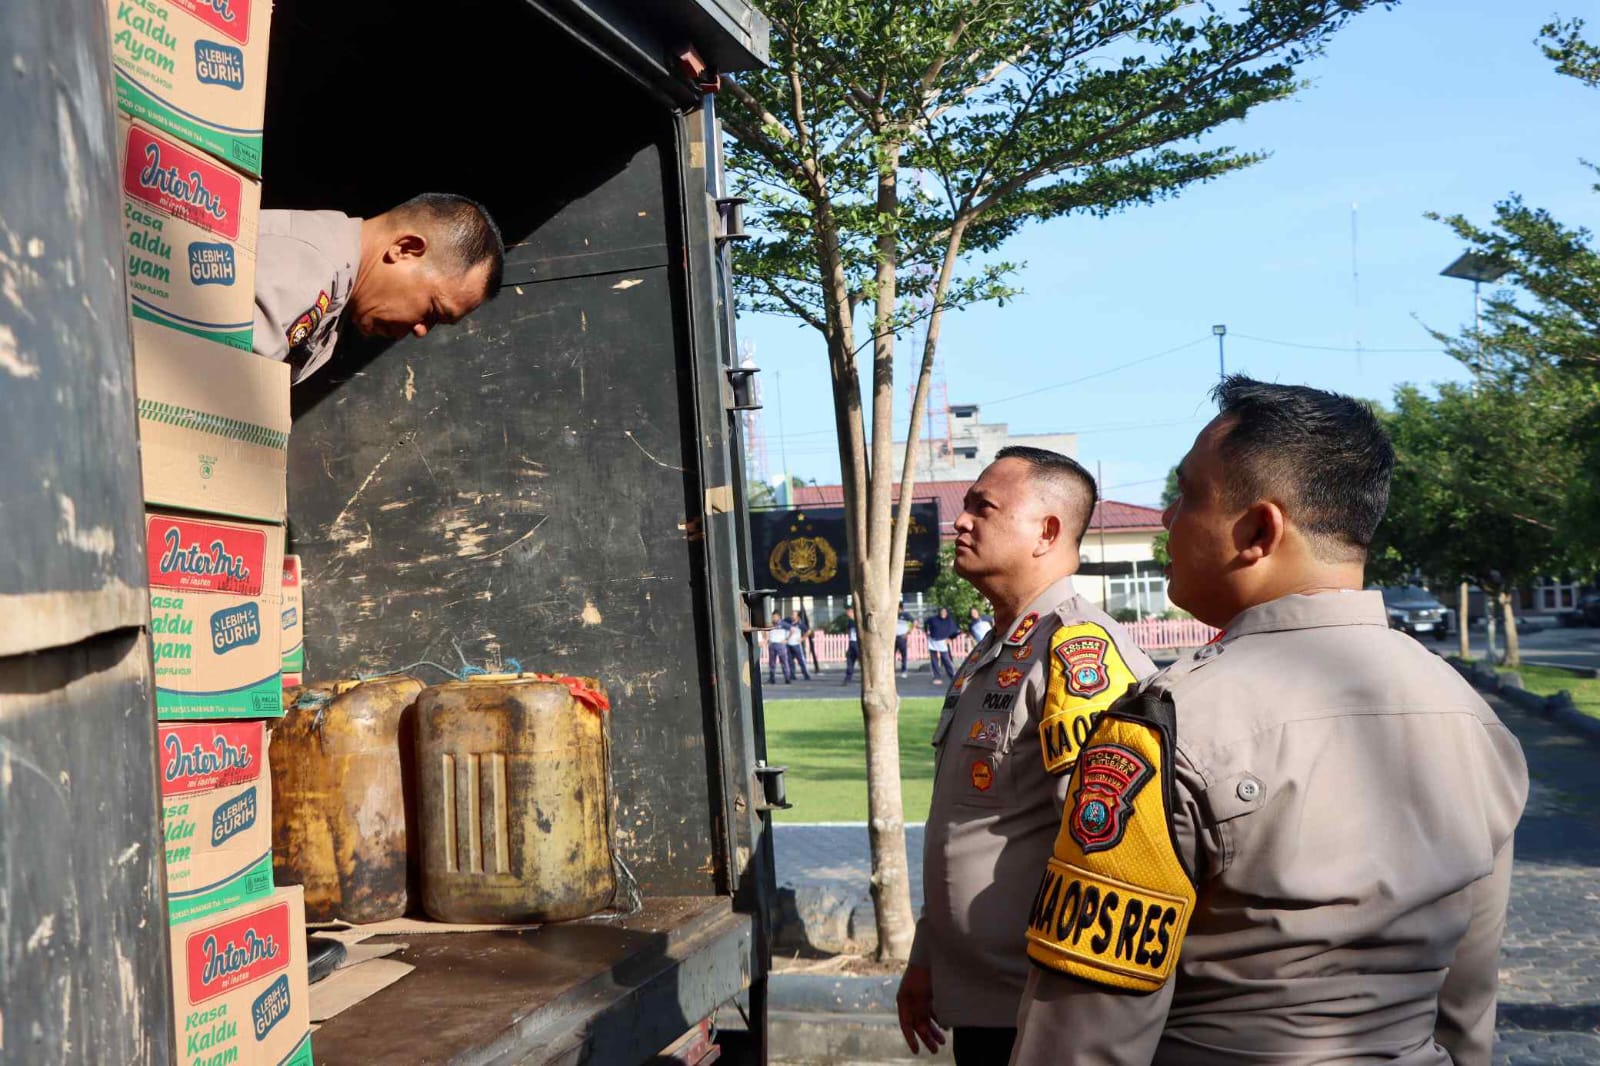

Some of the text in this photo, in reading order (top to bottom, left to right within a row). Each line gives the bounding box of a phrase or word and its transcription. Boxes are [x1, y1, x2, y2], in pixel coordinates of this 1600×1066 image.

[134, 0, 168, 22] asa
[117, 3, 176, 51] Kaldu
[114, 30, 174, 75] Ayam
[206, 50, 232, 66] LEBIH
[198, 63, 241, 83] GURIH
[141, 143, 226, 219] InterMi
[129, 231, 171, 260] aldu
[198, 249, 225, 264] LEBIH
[128, 255, 170, 283] yam
[192, 263, 233, 280] GURIH
[160, 526, 250, 580] InterMi
[151, 596, 184, 610] asa
[151, 613, 193, 636] aldu
[220, 610, 248, 631] LEBIH
[214, 621, 258, 649] GURIH
[153, 642, 192, 664] yam
[982, 693, 1014, 710] POLRI
[165, 733, 252, 782] InterMi
[214, 803, 254, 840] GURIH
[222, 796, 247, 822] LEBIH
[165, 819, 195, 842] ldu
[166, 846, 191, 864] am
[202, 928, 279, 986] InterMi
[260, 986, 281, 1014] LEBIH
[185, 1003, 227, 1031] Rasa
[256, 994, 289, 1035] GURIH
[186, 1019, 238, 1057] Kaldu
